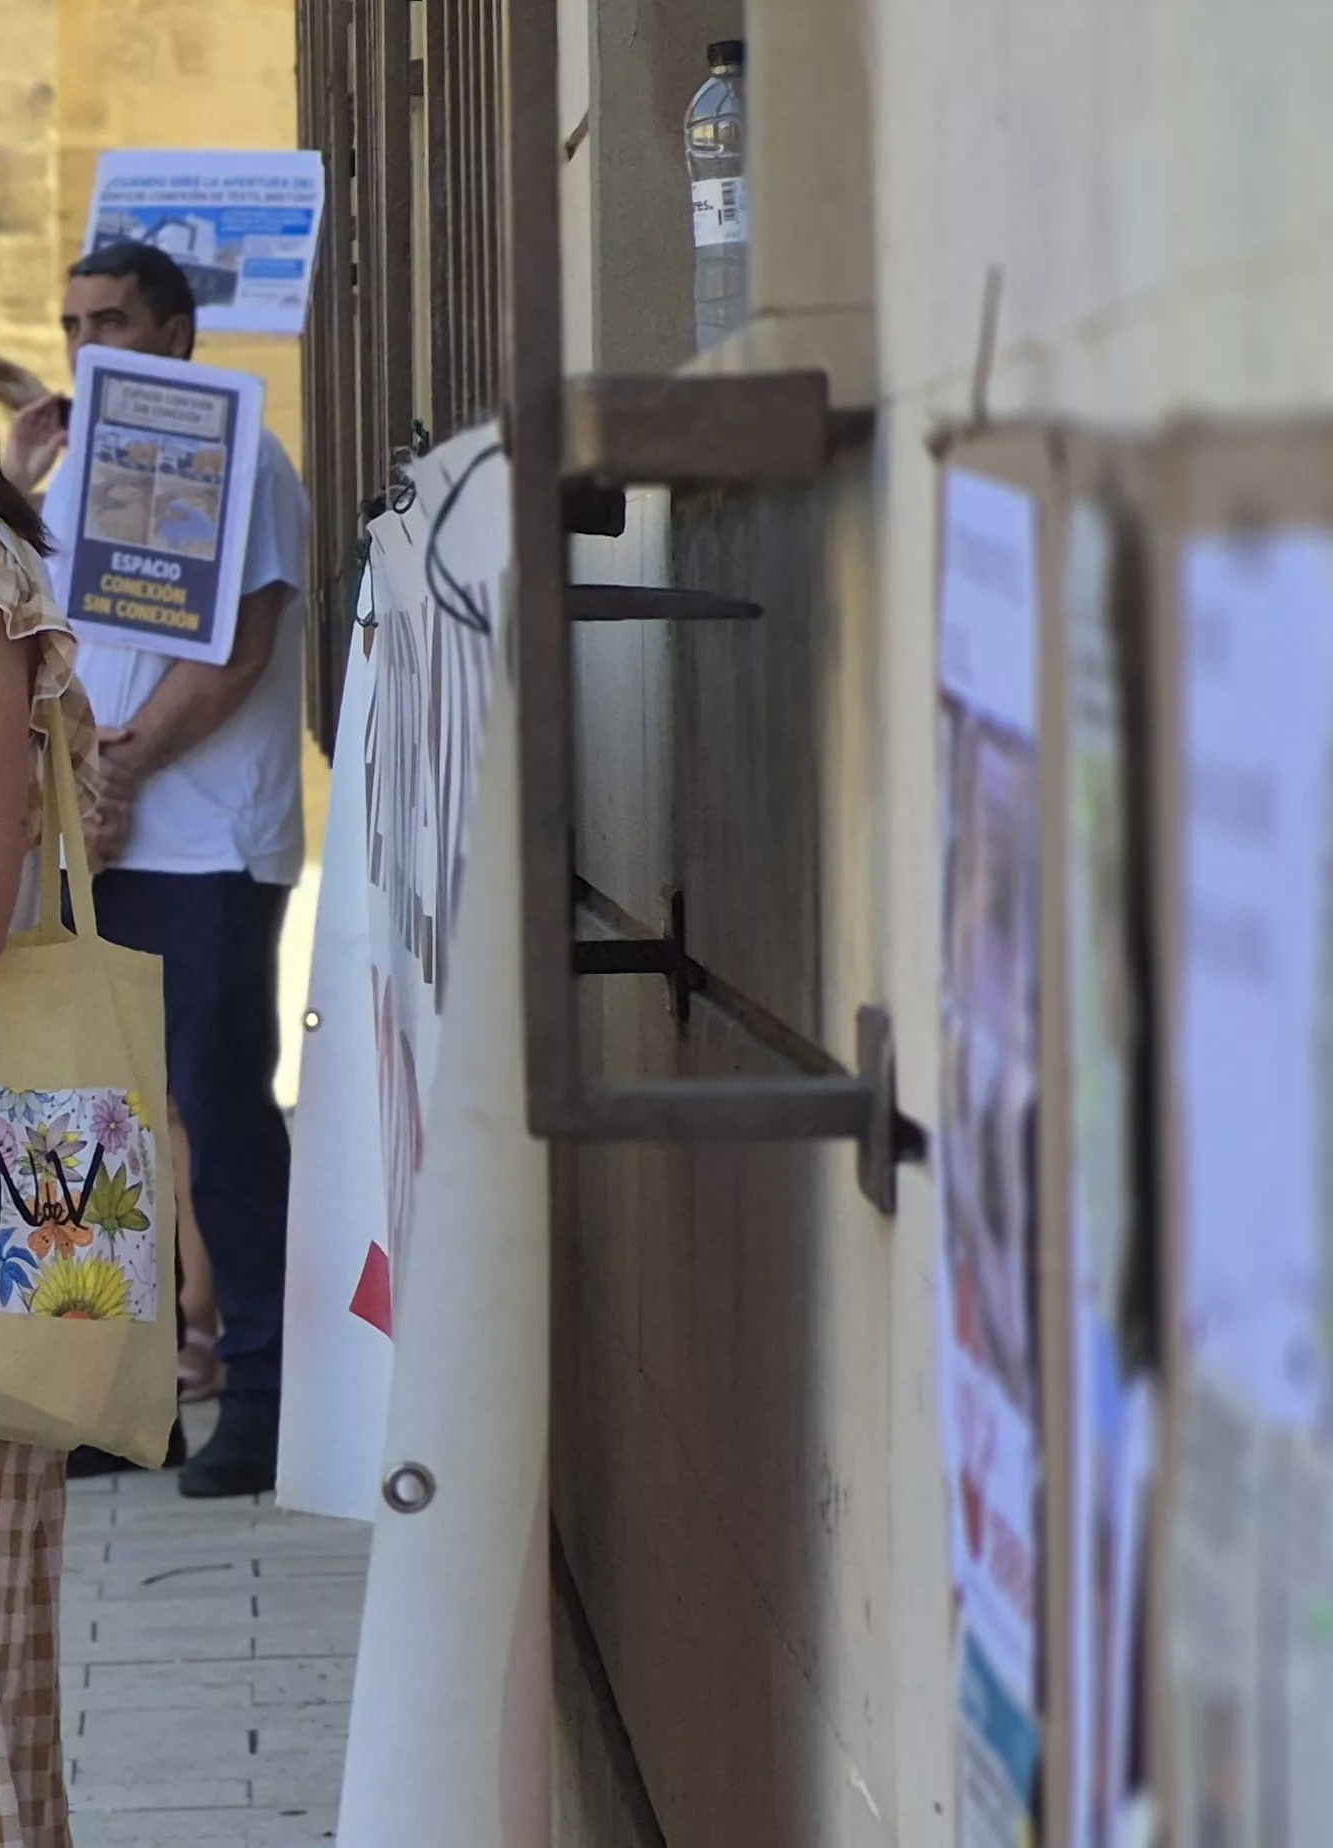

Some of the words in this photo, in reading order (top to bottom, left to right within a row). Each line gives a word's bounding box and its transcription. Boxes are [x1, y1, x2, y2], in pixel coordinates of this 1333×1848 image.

[111, 551, 182, 582] ESPACIO
[100, 573, 187, 605] CONEXIÓN
[82, 593, 112, 616] SIN
[115, 600, 199, 631] CONEXIÓN
